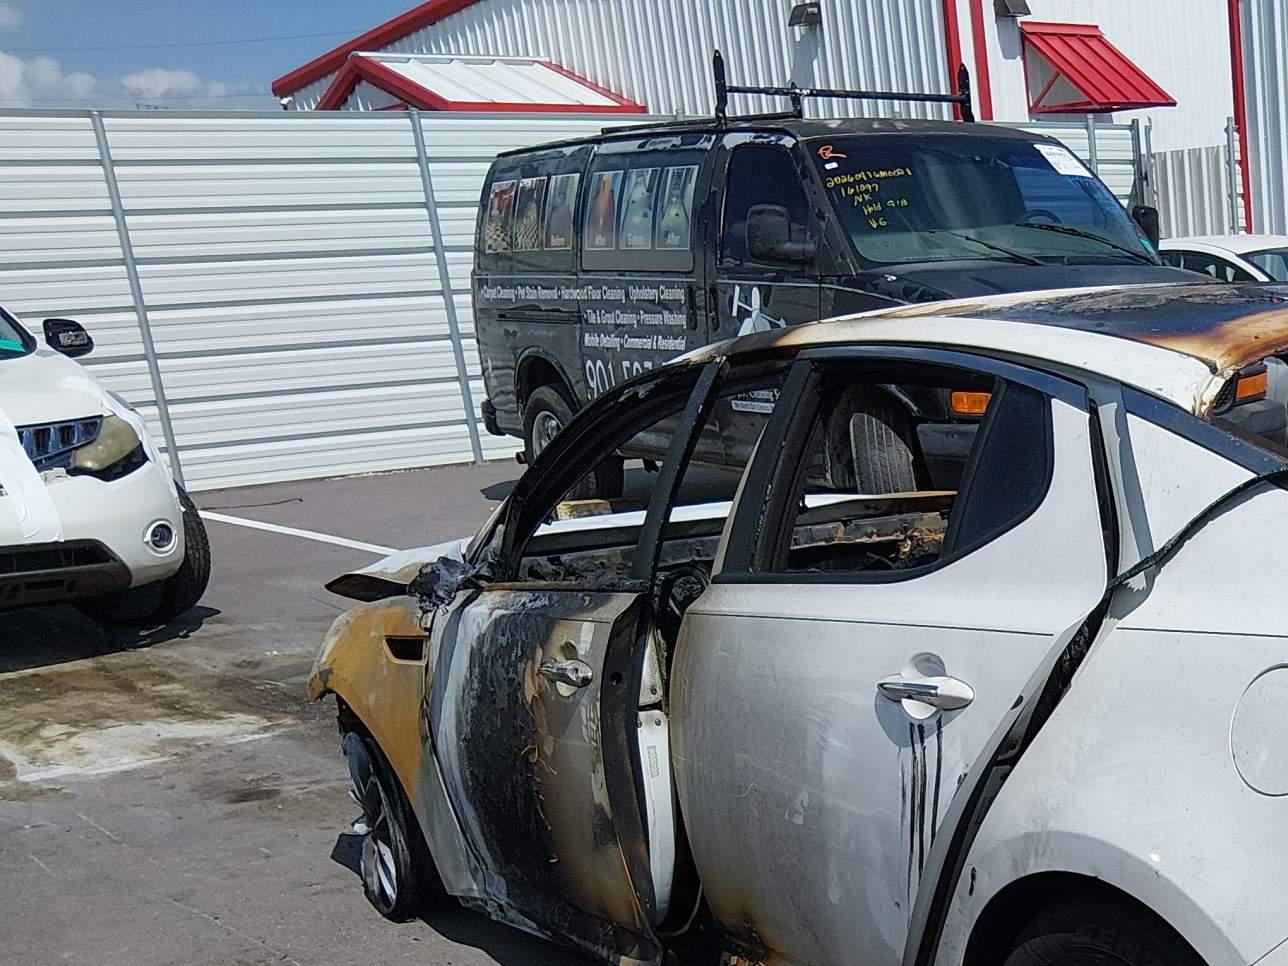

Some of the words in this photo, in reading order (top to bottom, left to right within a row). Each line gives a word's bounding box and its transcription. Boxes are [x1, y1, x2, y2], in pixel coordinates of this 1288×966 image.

[588, 286, 602, 300] Floor
[602, 286, 626, 304] Cleaning
[628, 285, 659, 304] Upholstery
[659, 285, 685, 305] Cleaning
[615, 309, 637, 328] Cleaning
[640, 310, 663, 325] Pressure
[663, 309, 687, 329] Washing
[624, 334, 652, 349] Commercial
[658, 335, 687, 351] Residential
